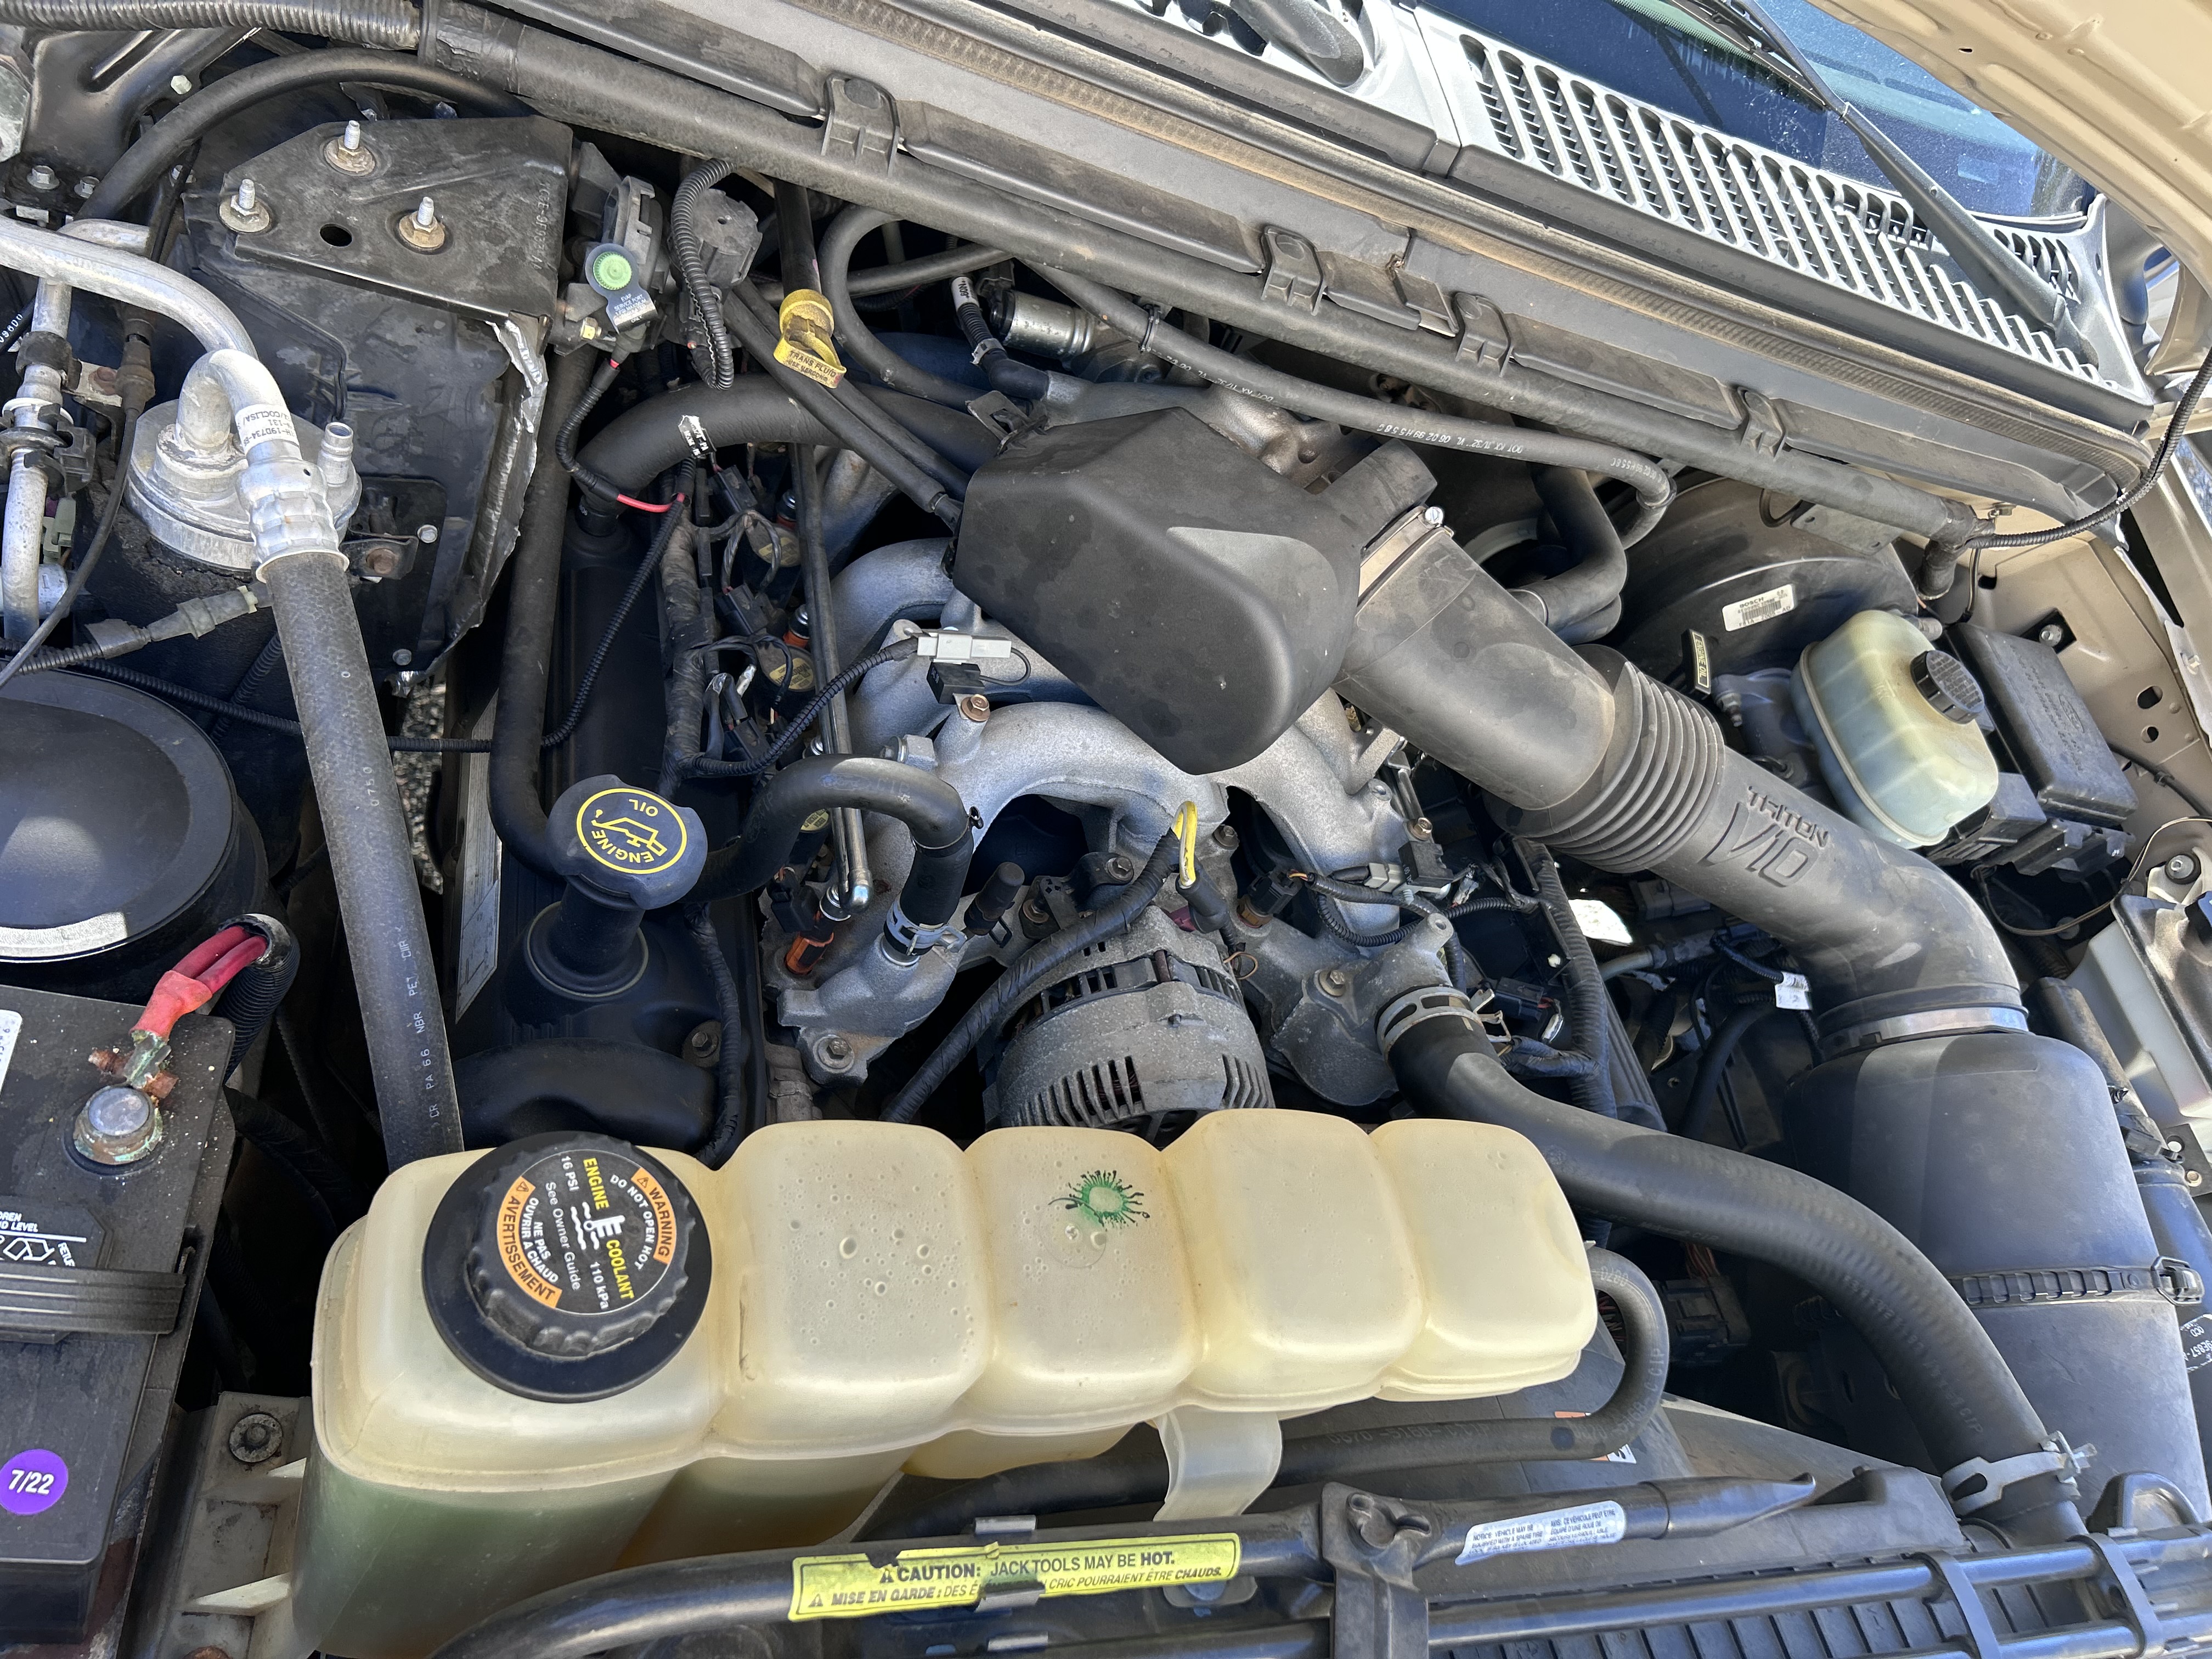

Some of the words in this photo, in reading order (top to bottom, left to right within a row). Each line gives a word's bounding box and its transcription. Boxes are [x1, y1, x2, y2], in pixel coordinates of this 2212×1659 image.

[614, 300, 633, 311] SERVICE
[631, 294, 645, 303] PORT
[620, 294, 631, 302] EVAP
[625, 298, 646, 311] MAXIMUM
[790, 351, 814, 366] TRANS
[815, 363, 836, 378] FLUID
[1739, 597, 1764, 608] BOSCH
[1695, 639, 1705, 665] ENGINE
[629, 799, 658, 817] OIL
[1748, 786, 1831, 848] TRITON
[591, 830, 654, 864] ENGINE
[1697, 802, 1819, 888] V10
[414, 1011, 426, 1034] NBR
[420, 1048, 432, 1066] 66
[425, 1074, 435, 1090] PA
[561, 1156, 573, 1170] 16
[565, 1172, 579, 1192] PSI
[583, 1158, 610, 1211] ENGINE
[610, 1174, 628, 1188] DO
[627, 1186, 648, 1208] NOT
[10, 1222, 38, 1232] LEVEL
[521, 1197, 539, 1238] OUVRIR
[533, 1221, 544, 1237] NE
[642, 1211, 655, 1243] OPEN
[648, 1187, 673, 1257] WARNING
[502, 1195, 556, 1300] AVERTISSEMENT
[545, 1182, 558, 1205] See
[552, 1208, 570, 1249] Owner
[564, 1251, 581, 1290] Guide
[534, 1238, 551, 1260] PAS
[634, 1245, 652, 1271] HOT
[527, 1250, 558, 1283] CHAUD
[590, 1261, 604, 1283] 110
[606, 1239, 635, 1300] COOLANT
[596, 1286, 609, 1310] kPa
[8, 1470, 55, 1495] 7/22
[1494, 1526, 1515, 1537] VEHICLE
[898, 1562, 981, 1582] CAUTION:
[990, 1560, 1030, 1577] JACK
[1032, 1556, 1080, 1573] TOOLS
[1084, 1554, 1114, 1570] MAY
[1117, 1553, 1136, 1568] BE
[1140, 1550, 1175, 1566] HOT.
[831, 1591, 865, 1606] MISE
[868, 1589, 887, 1602] EN
[944, 1584, 967, 1598] DES
[1048, 1576, 1075, 1589] CRIC
[1077, 1572, 1144, 1587] POURRAIENT
[1147, 1568, 1173, 1582] ÊTRE
[1175, 1566, 1222, 1579] CHAUDS.
